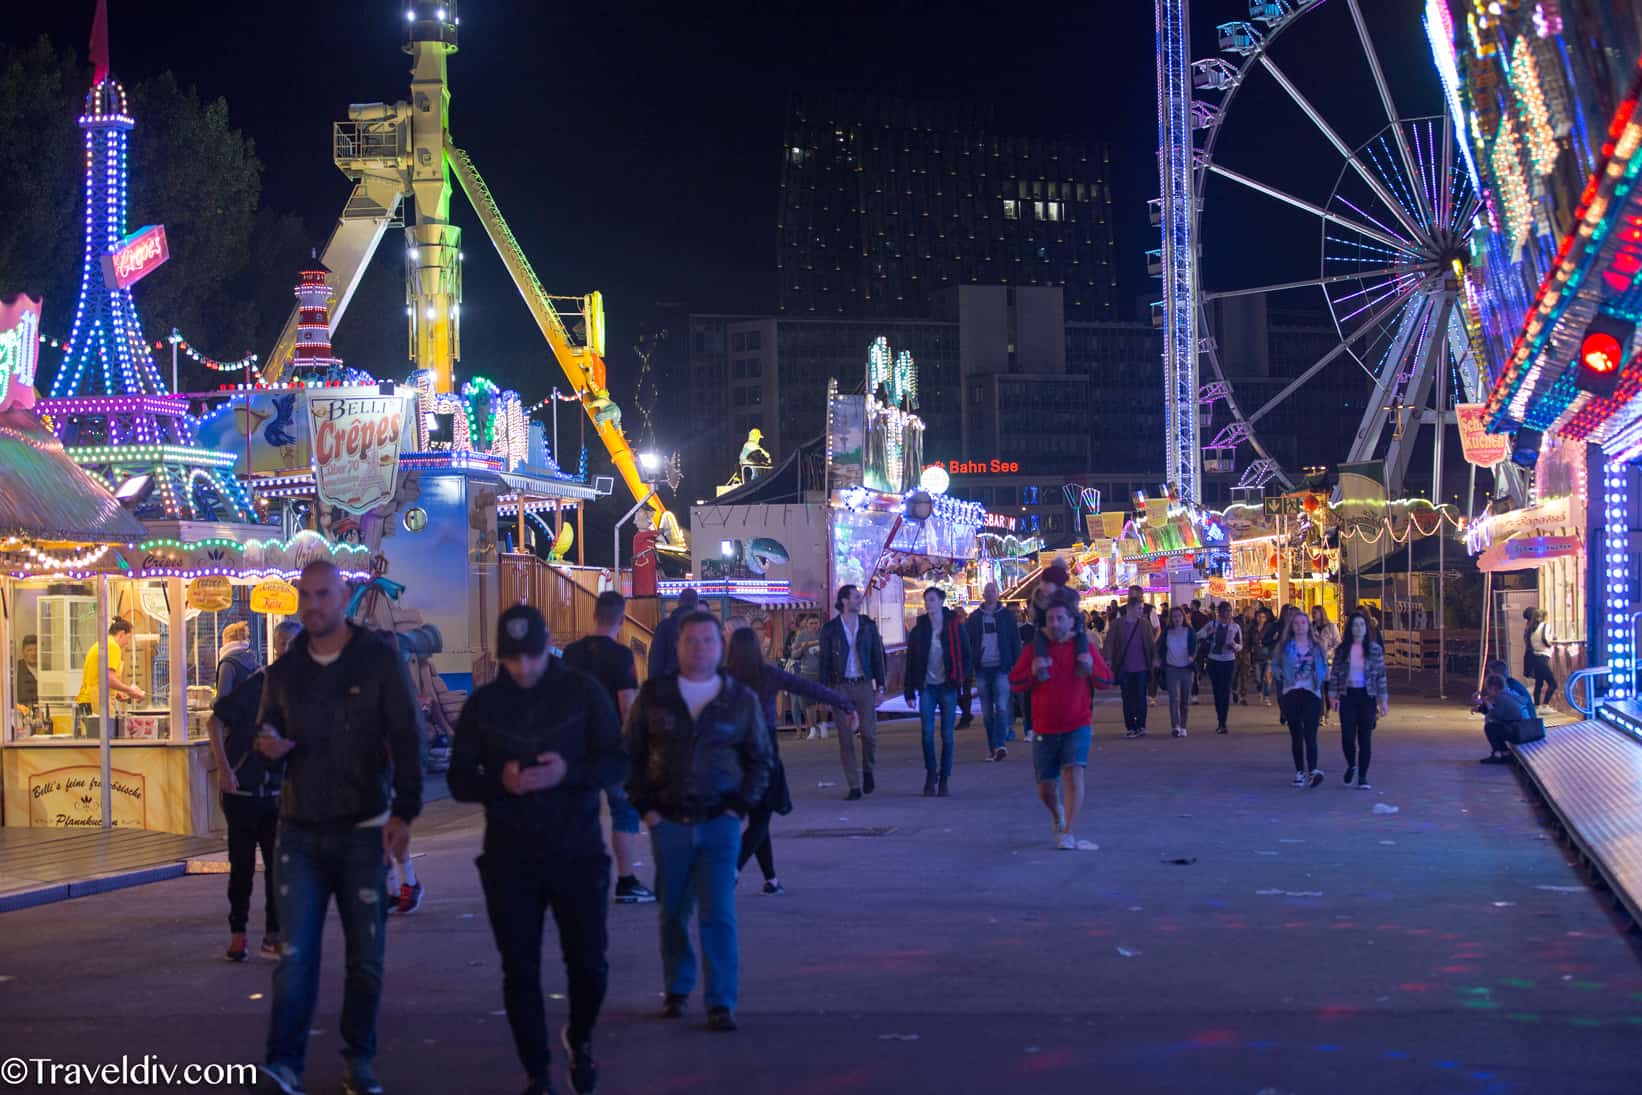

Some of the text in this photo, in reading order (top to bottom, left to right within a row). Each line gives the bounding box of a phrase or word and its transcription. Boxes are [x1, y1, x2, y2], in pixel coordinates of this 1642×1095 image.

[316, 414, 400, 466] Crêpes
[949, 460, 987, 474] Bahn
[989, 459, 1019, 473] See
[32, 781, 61, 799] Belli's
[65, 777, 85, 792] feine
